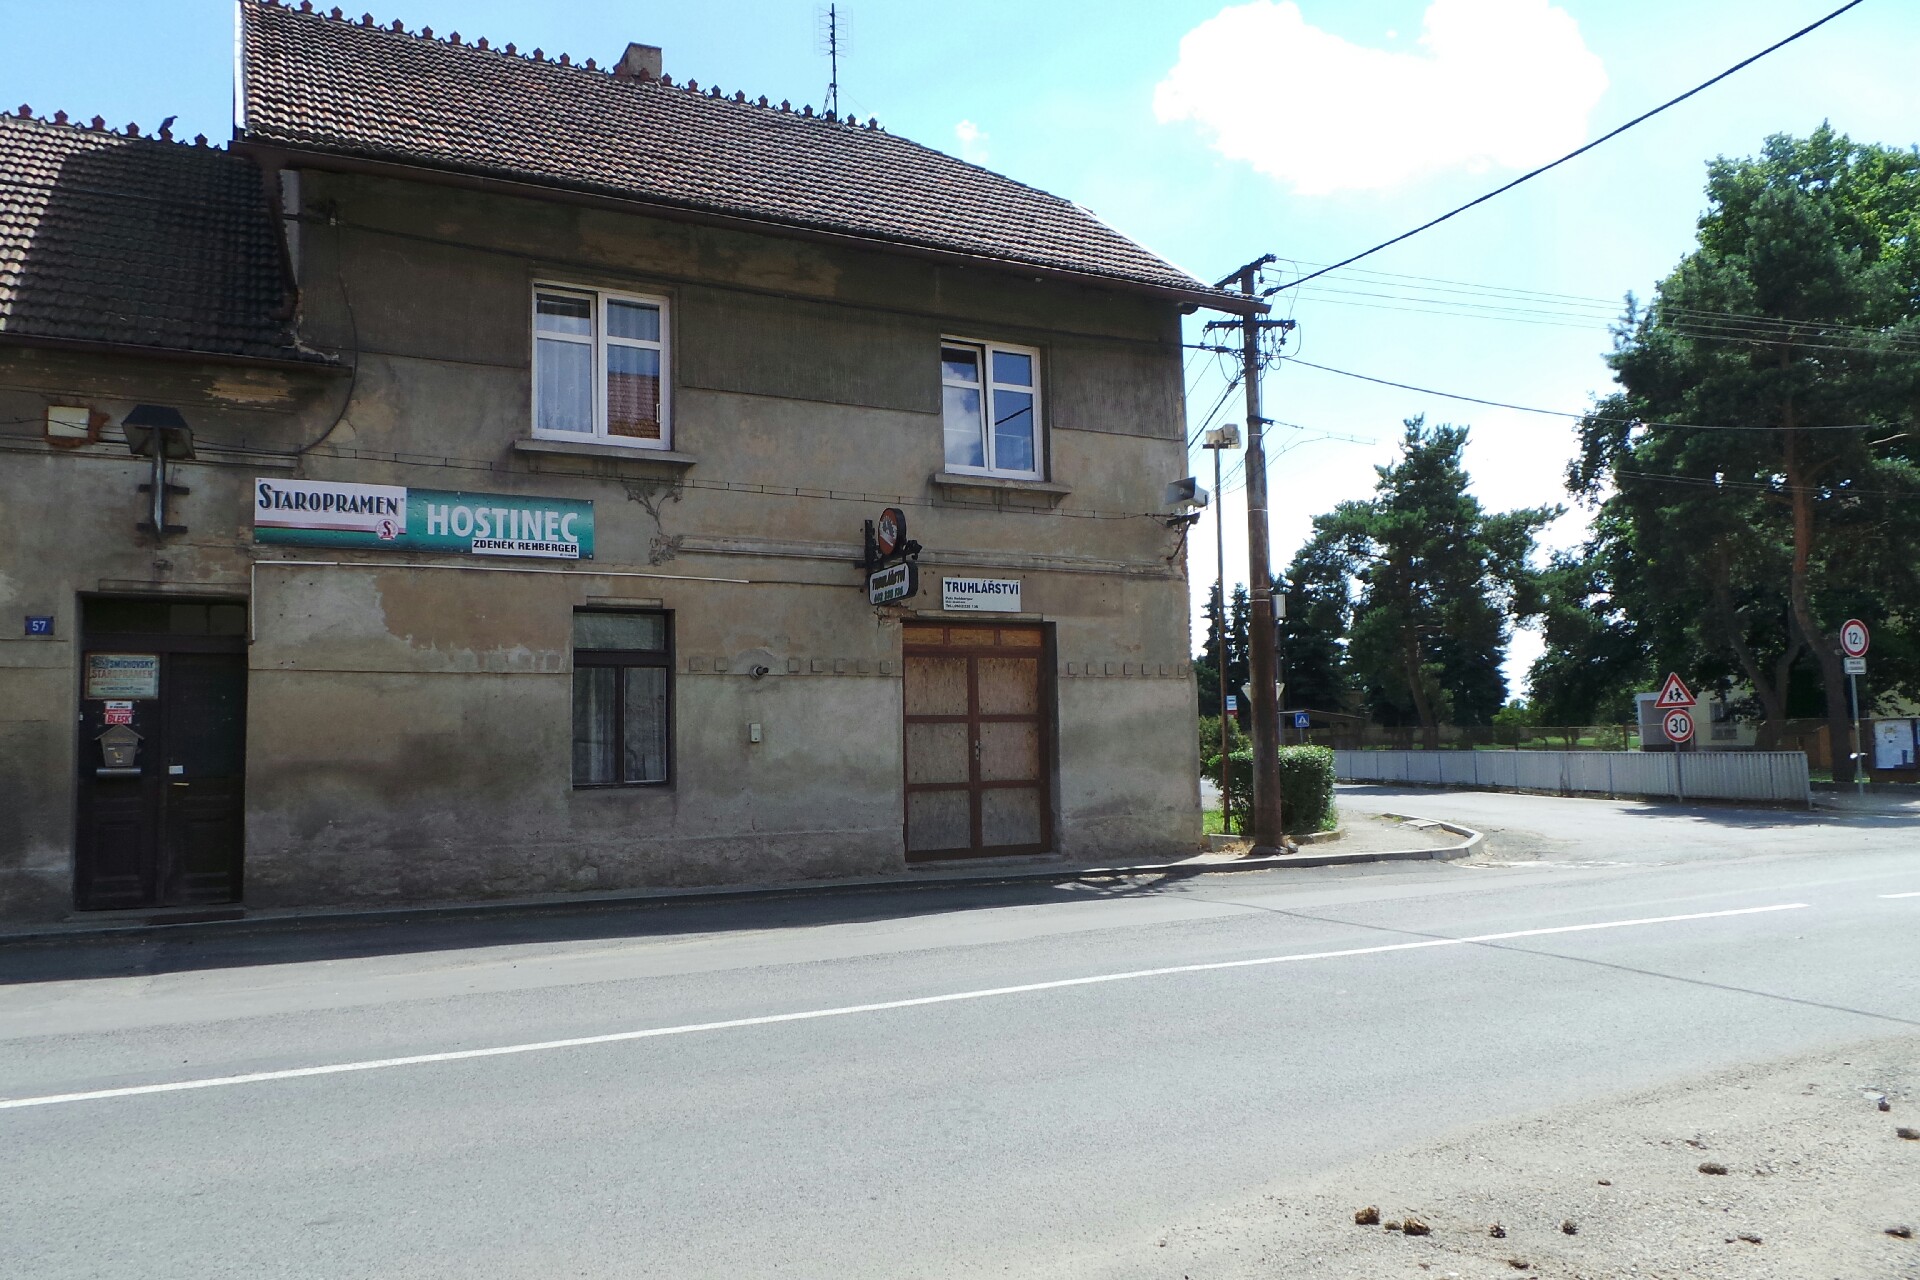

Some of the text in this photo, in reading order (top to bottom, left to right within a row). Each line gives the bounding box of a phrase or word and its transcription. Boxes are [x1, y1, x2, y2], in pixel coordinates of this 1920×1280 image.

[258, 483, 400, 516] STAROPRAMEN
[427, 504, 578, 542] HOSTINEC
[473, 539, 577, 553] ZDENĚK REHBERGER
[945, 580, 1019, 595] TRUHLÁŘSTVÍ
[32, 620, 46, 631] 57
[107, 714, 131, 724] BLESK
[1670, 718, 1688, 733] 30
